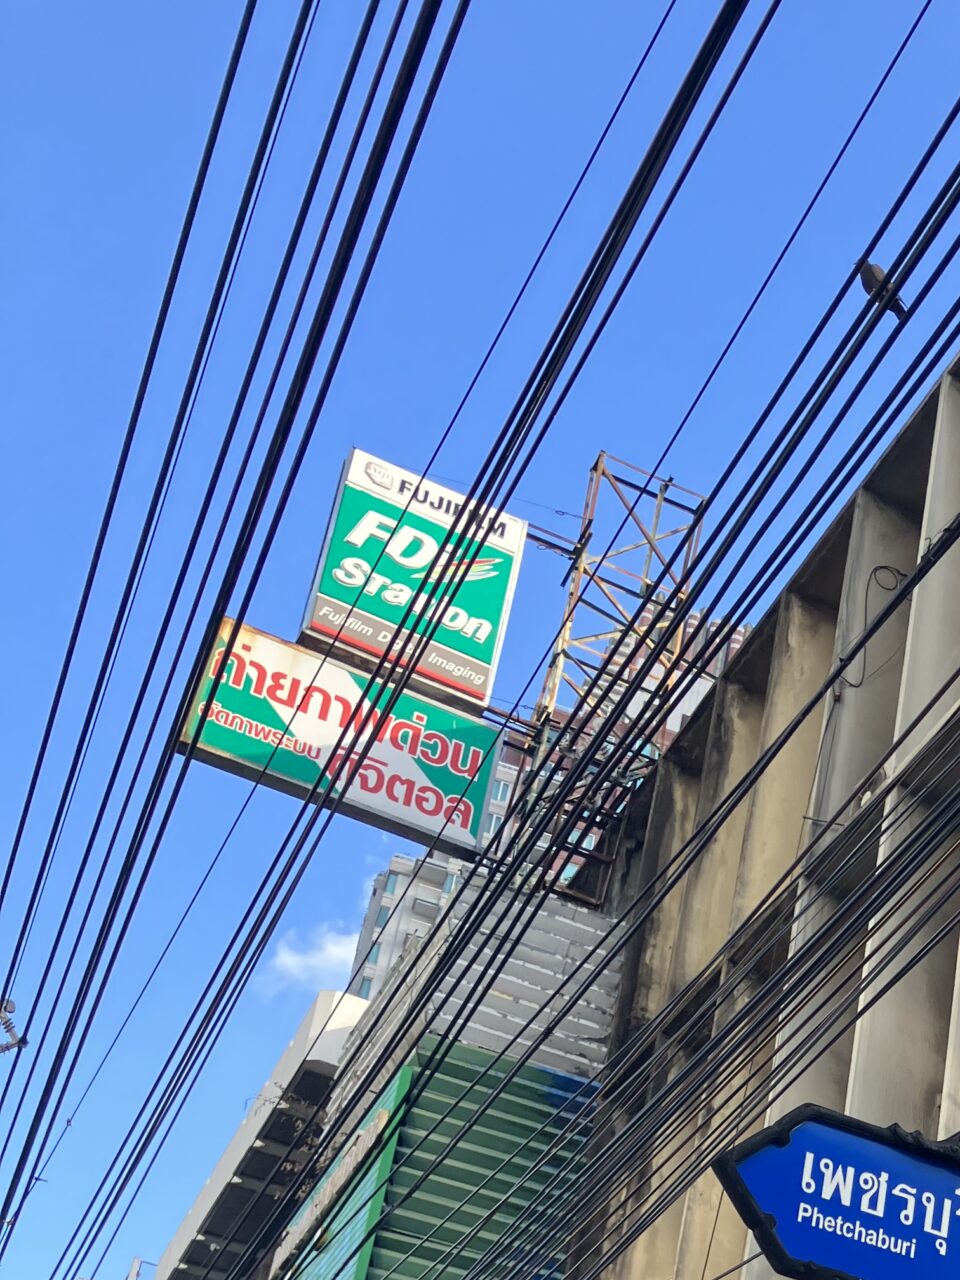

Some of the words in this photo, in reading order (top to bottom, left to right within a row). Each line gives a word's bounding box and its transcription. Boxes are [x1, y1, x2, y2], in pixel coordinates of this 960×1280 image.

[397, 479, 507, 539] FUJIFLM
[318, 606, 374, 637] Fujifilm
[428, 652, 486, 685] Imaging
[210, 643, 485, 783] ถ่ายภาพด่วน
[797, 1202, 917, 1259] Phetchaburi
